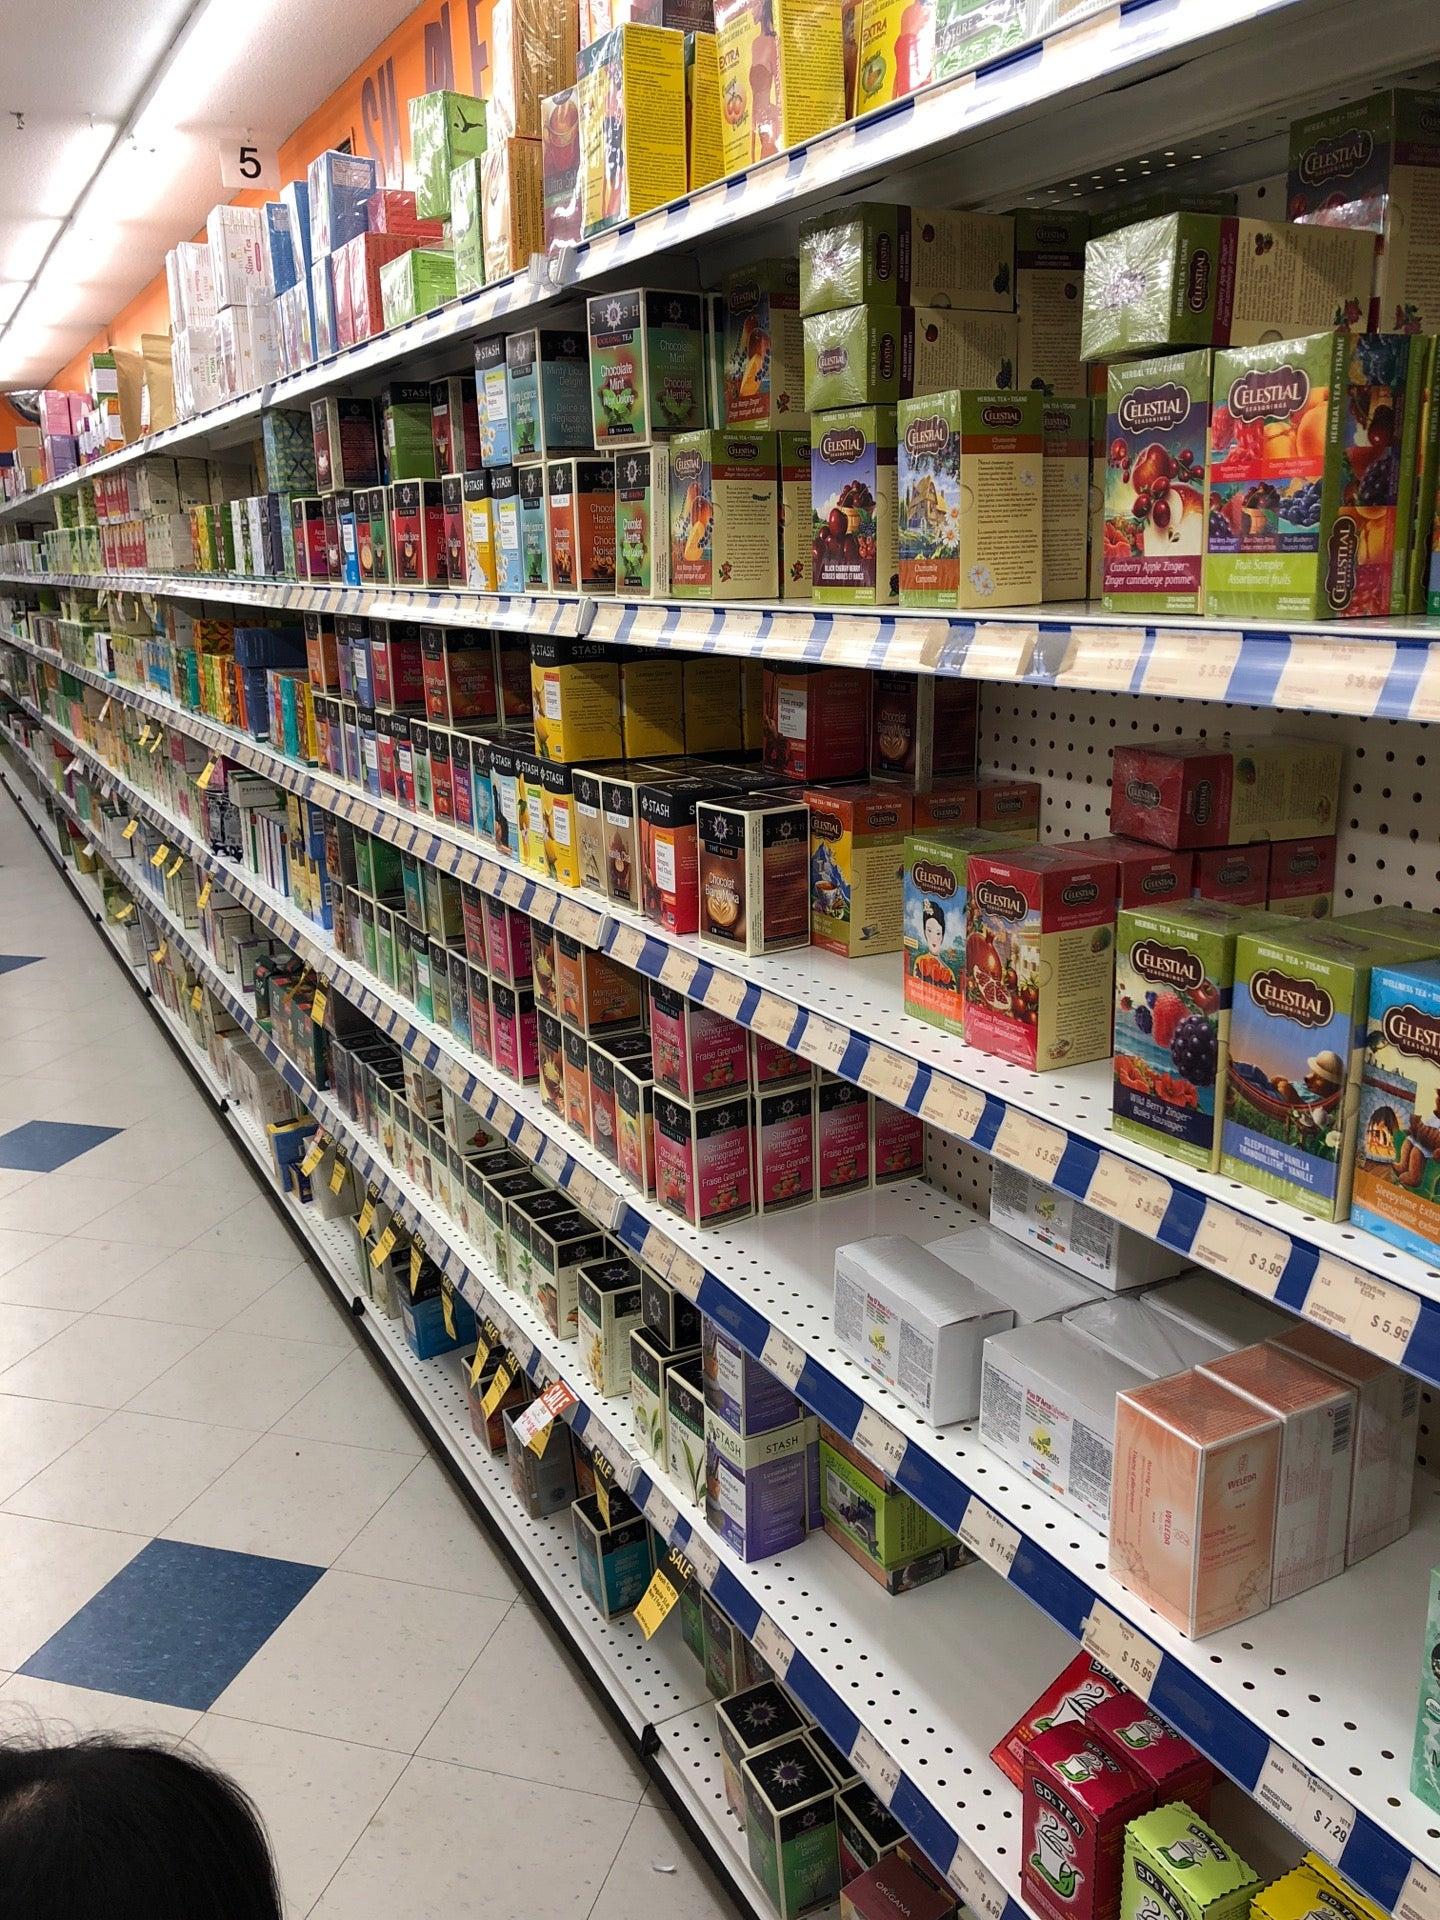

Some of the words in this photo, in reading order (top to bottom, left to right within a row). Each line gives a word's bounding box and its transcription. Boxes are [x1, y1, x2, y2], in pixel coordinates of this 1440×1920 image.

[863, 18, 888, 42] EXTRA
[719, 47, 740, 67] EXTRA
[239, 146, 262, 179] 5
[1305, 144, 1367, 174] CELESTIAL
[1192, 254, 1206, 306] CELESTIAL
[622, 333, 633, 342] TEA
[482, 344, 500, 359] STASH
[669, 352, 685, 363] Mint
[1336, 336, 1345, 375] TISANE
[600, 363, 633, 378] Chocolate
[1122, 367, 1140, 380] HERBAL
[1142, 364, 1158, 376] TEA
[1164, 361, 1185, 374] TISANE
[609, 377, 625, 390] Mint
[1233, 383, 1302, 406] CELESTIAL
[1333, 382, 1342, 406] TEA
[983, 409, 1020, 421] CELESTIAL
[1125, 398, 1181, 420] CELESTIAL
[1245, 401, 1288, 413] SEASONINGS
[1134, 414, 1172, 426] SEASONINGS
[1330, 407, 1340, 444] HERBAL
[908, 423, 948, 445] CELESTIAL
[728, 446, 757, 456] CELESTIAL
[823, 437, 862, 456] CELESTIAL
[676, 456, 702, 473] CELESTIAL
[467, 478, 484, 491] STASH
[495, 476, 512, 490] STASH
[824, 565, 837, 573] BLACK
[837, 565, 850, 573] CHERRY
[850, 565, 862, 573] BERRY
[914, 563, 938, 573] Chamomile
[1110, 561, 1141, 574] Cranberry
[1142, 561, 1161, 574] Apple
[1236, 559, 1252, 571] Fruit
[1253, 559, 1285, 573] Sampler
[1332, 527, 1351, 605] CELESTIAL
[1105, 574, 1125, 587] Zinger
[1125, 574, 1163, 588] canneberge
[1164, 574, 1192, 587] pomme
[1227, 572, 1269, 587] Assortiment
[1269, 571, 1293, 587] fruits
[536, 644, 555, 657] STASH
[572, 645, 605, 655] STASH
[394, 721, 408, 734] STASH
[495, 753, 512, 768] STASH
[521, 762, 539, 777] STASH
[545, 768, 565, 785] STASH
[649, 801, 671, 818] STASH
[811, 816, 838, 834] CELESTIAL
[869, 815, 897, 824] CELESTIAL
[708, 843, 721, 854] THÉ
[722, 847, 734, 856] NOIR
[709, 872, 735, 889] Chocolat
[915, 867, 953, 890] CELESTIAL
[979, 890, 1022, 913] CELESTIAL
[1064, 888, 1096, 899] CELESTIAL
[1134, 919, 1157, 933] HERBAL
[1158, 925, 1172, 936] TEA
[1177, 928, 1199, 942] TISANE
[1136, 948, 1197, 981] CELESTIAL
[1258, 947, 1280, 961] HERBAL
[1283, 956, 1299, 966] TEA
[1305, 961, 1330, 975] TISANE
[1147, 966, 1185, 983] SEASONINGS
[1382, 978, 1413, 995] WELLNESS
[1414, 987, 1427, 998] TEA
[1256, 978, 1325, 1017] CELESTIAL
[1268, 1000, 1310, 1018] SEASONINGS
[655, 1024, 682, 1042] Strawberry
[695, 1049, 715, 1062] Fraise
[717, 1044, 745, 1058] Grenade
[1129, 1093, 1144, 1106] Wild
[1145, 1097, 1164, 1112] Berry
[1165, 1103, 1188, 1122] Zinger
[829, 1113, 861, 1127] Strawberry
[1132, 1107, 1151, 1120] Baies
[1151, 1112, 1185, 1132] sauvages
[772, 1126, 805, 1140] Strawberry
[825, 1121, 864, 1137] Pomegranate
[877, 1136, 897, 1147] Fraise
[897, 1129, 921, 1143] Grenade
[675, 1133, 686, 1144] TEA
[706, 1139, 741, 1154] Strawberry
[767, 1134, 809, 1151] Pomegranate
[659, 1148, 687, 1169] Strawberry
[703, 1145, 745, 1164] Pomegranate
[823, 1147, 841, 1159] Fraise
[842, 1142, 866, 1154] Grenade
[765, 1162, 786, 1174] Fraise
[786, 1154, 811, 1169] Grenade
[1284, 1151, 1310, 1171] VANILLA
[658, 1158, 691, 1183] Pomegranate
[702, 1175, 722, 1188] Fraise
[723, 1168, 748, 1182] Grenade
[1288, 1164, 1314, 1184] VANILLE
[1375, 1182, 1418, 1211] Sleepytime
[392, 1210, 405, 1228] SALE
[414, 1232, 426, 1250] SALE
[1249, 1253, 1257, 1266] $
[1258, 1256, 1282, 1279] 3.99
[484, 1319, 501, 1338] SALE
[1370, 1314, 1380, 1328] $
[1381, 1319, 1410, 1343] 5.99
[506, 1352, 520, 1373] SALE
[543, 1386, 570, 1416] SALE
[715, 1427, 742, 1458] STASH
[766, 1436, 799, 1454] STASH
[1029, 1436, 1041, 1451] New
[890, 1445, 902, 1462] 5.99
[593, 1450, 612, 1478] SALE
[1228, 1473, 1257, 1491] WELEDA
[1164, 1509, 1173, 1546] WELEDA
[990, 1537, 995, 1548] $
[669, 1547, 693, 1580] SALE
[1121, 1650, 1129, 1663] $
[1130, 1656, 1153, 1683] 15.99
[1058, 1800, 1080, 1834] TEA
[1314, 1809, 1322, 1823] $
[1323, 1817, 1348, 1844] 7.29
[875, 1881, 912, 1918] ORIGANA
